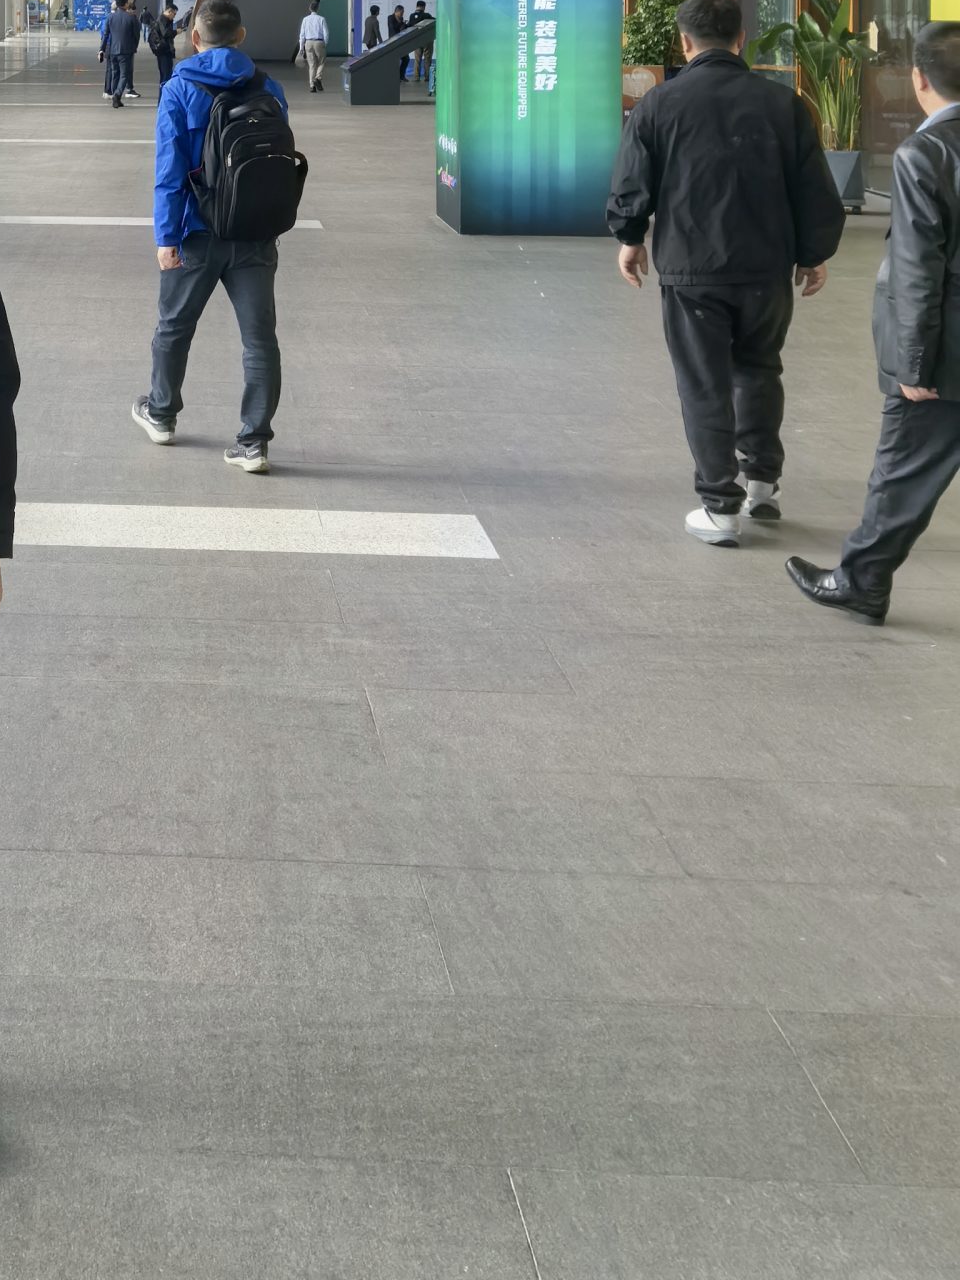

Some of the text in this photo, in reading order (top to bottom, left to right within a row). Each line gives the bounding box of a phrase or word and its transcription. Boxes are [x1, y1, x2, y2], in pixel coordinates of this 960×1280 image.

[517, 32, 528, 70] FUTURE
[534, 20, 558, 91] 装备美好
